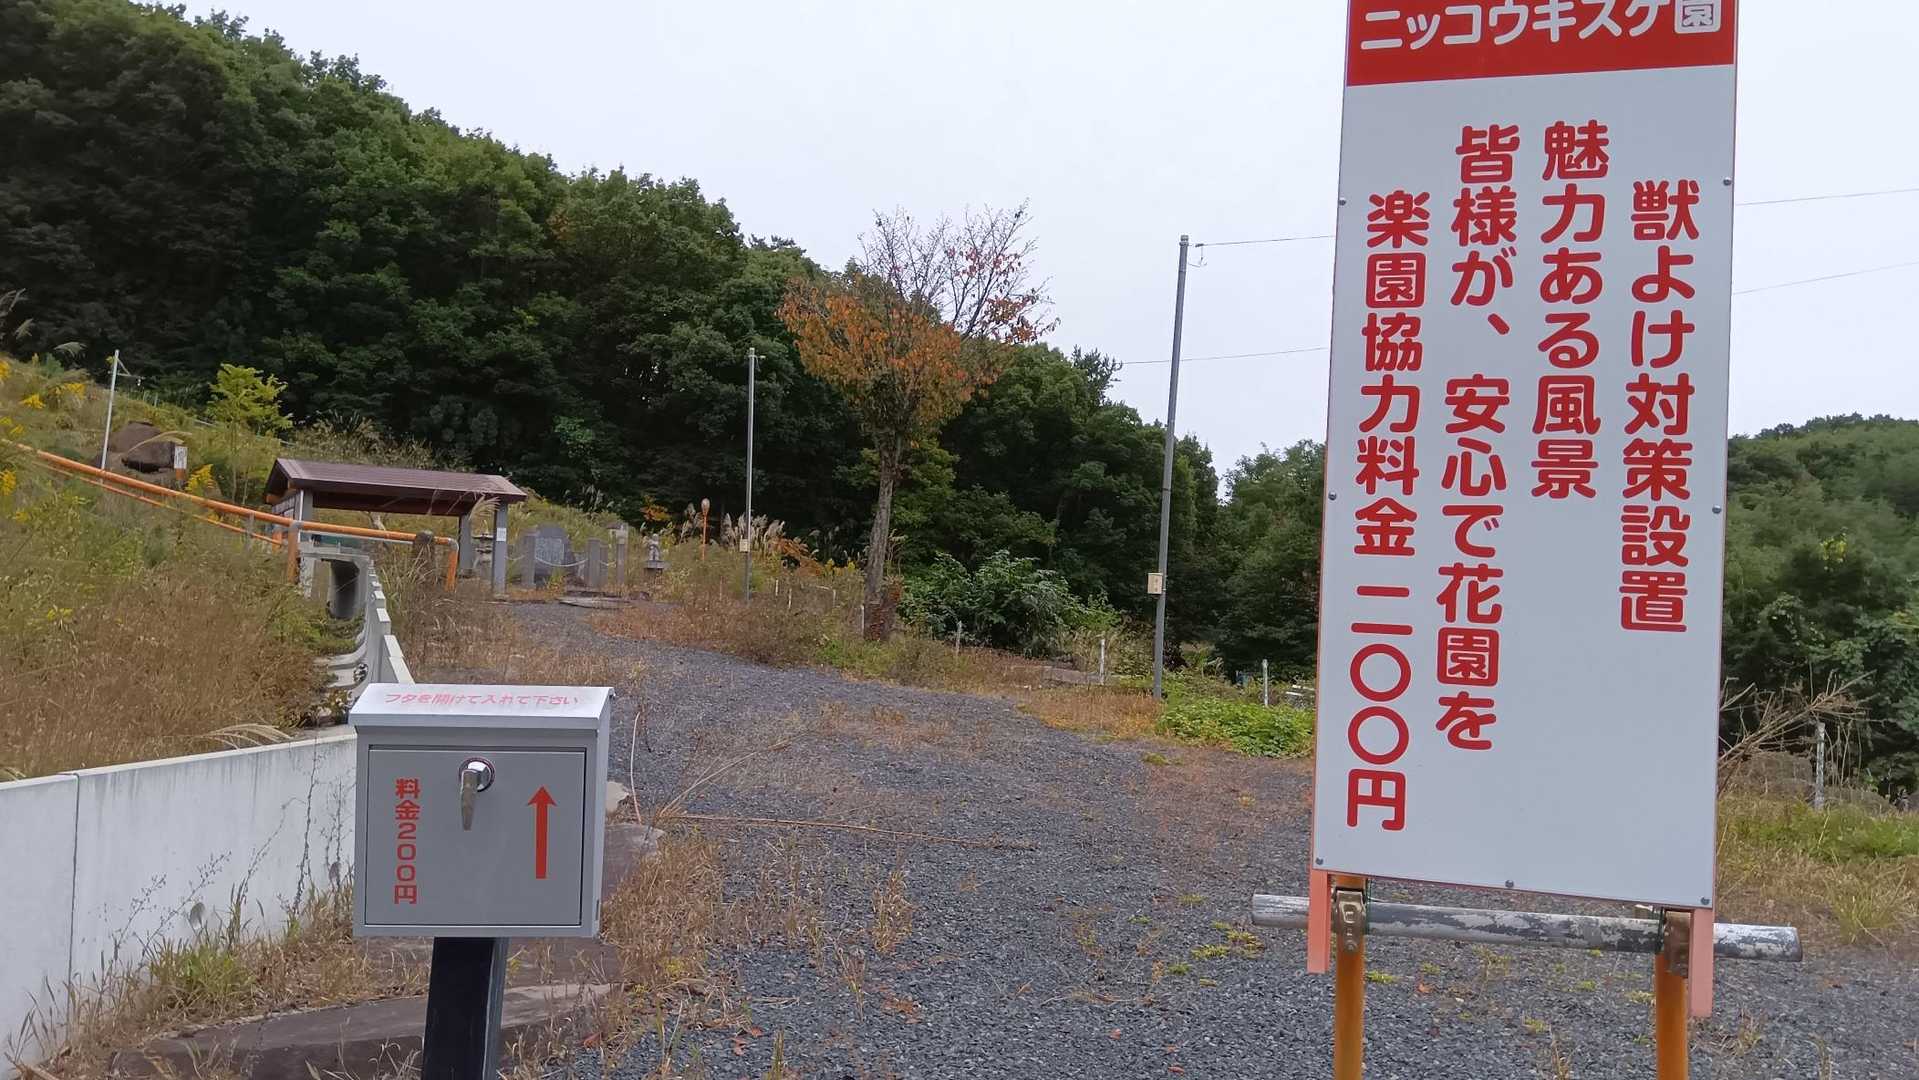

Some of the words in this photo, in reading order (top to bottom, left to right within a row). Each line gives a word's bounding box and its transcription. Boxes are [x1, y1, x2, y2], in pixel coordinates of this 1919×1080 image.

[1532, 120, 1610, 499] 魅力ある風景
[1621, 179, 1701, 633] 獣よけ対策設置
[385, 693, 580, 706] フタを開けて入れて下さい
[395, 778, 421, 905] 料金200円
